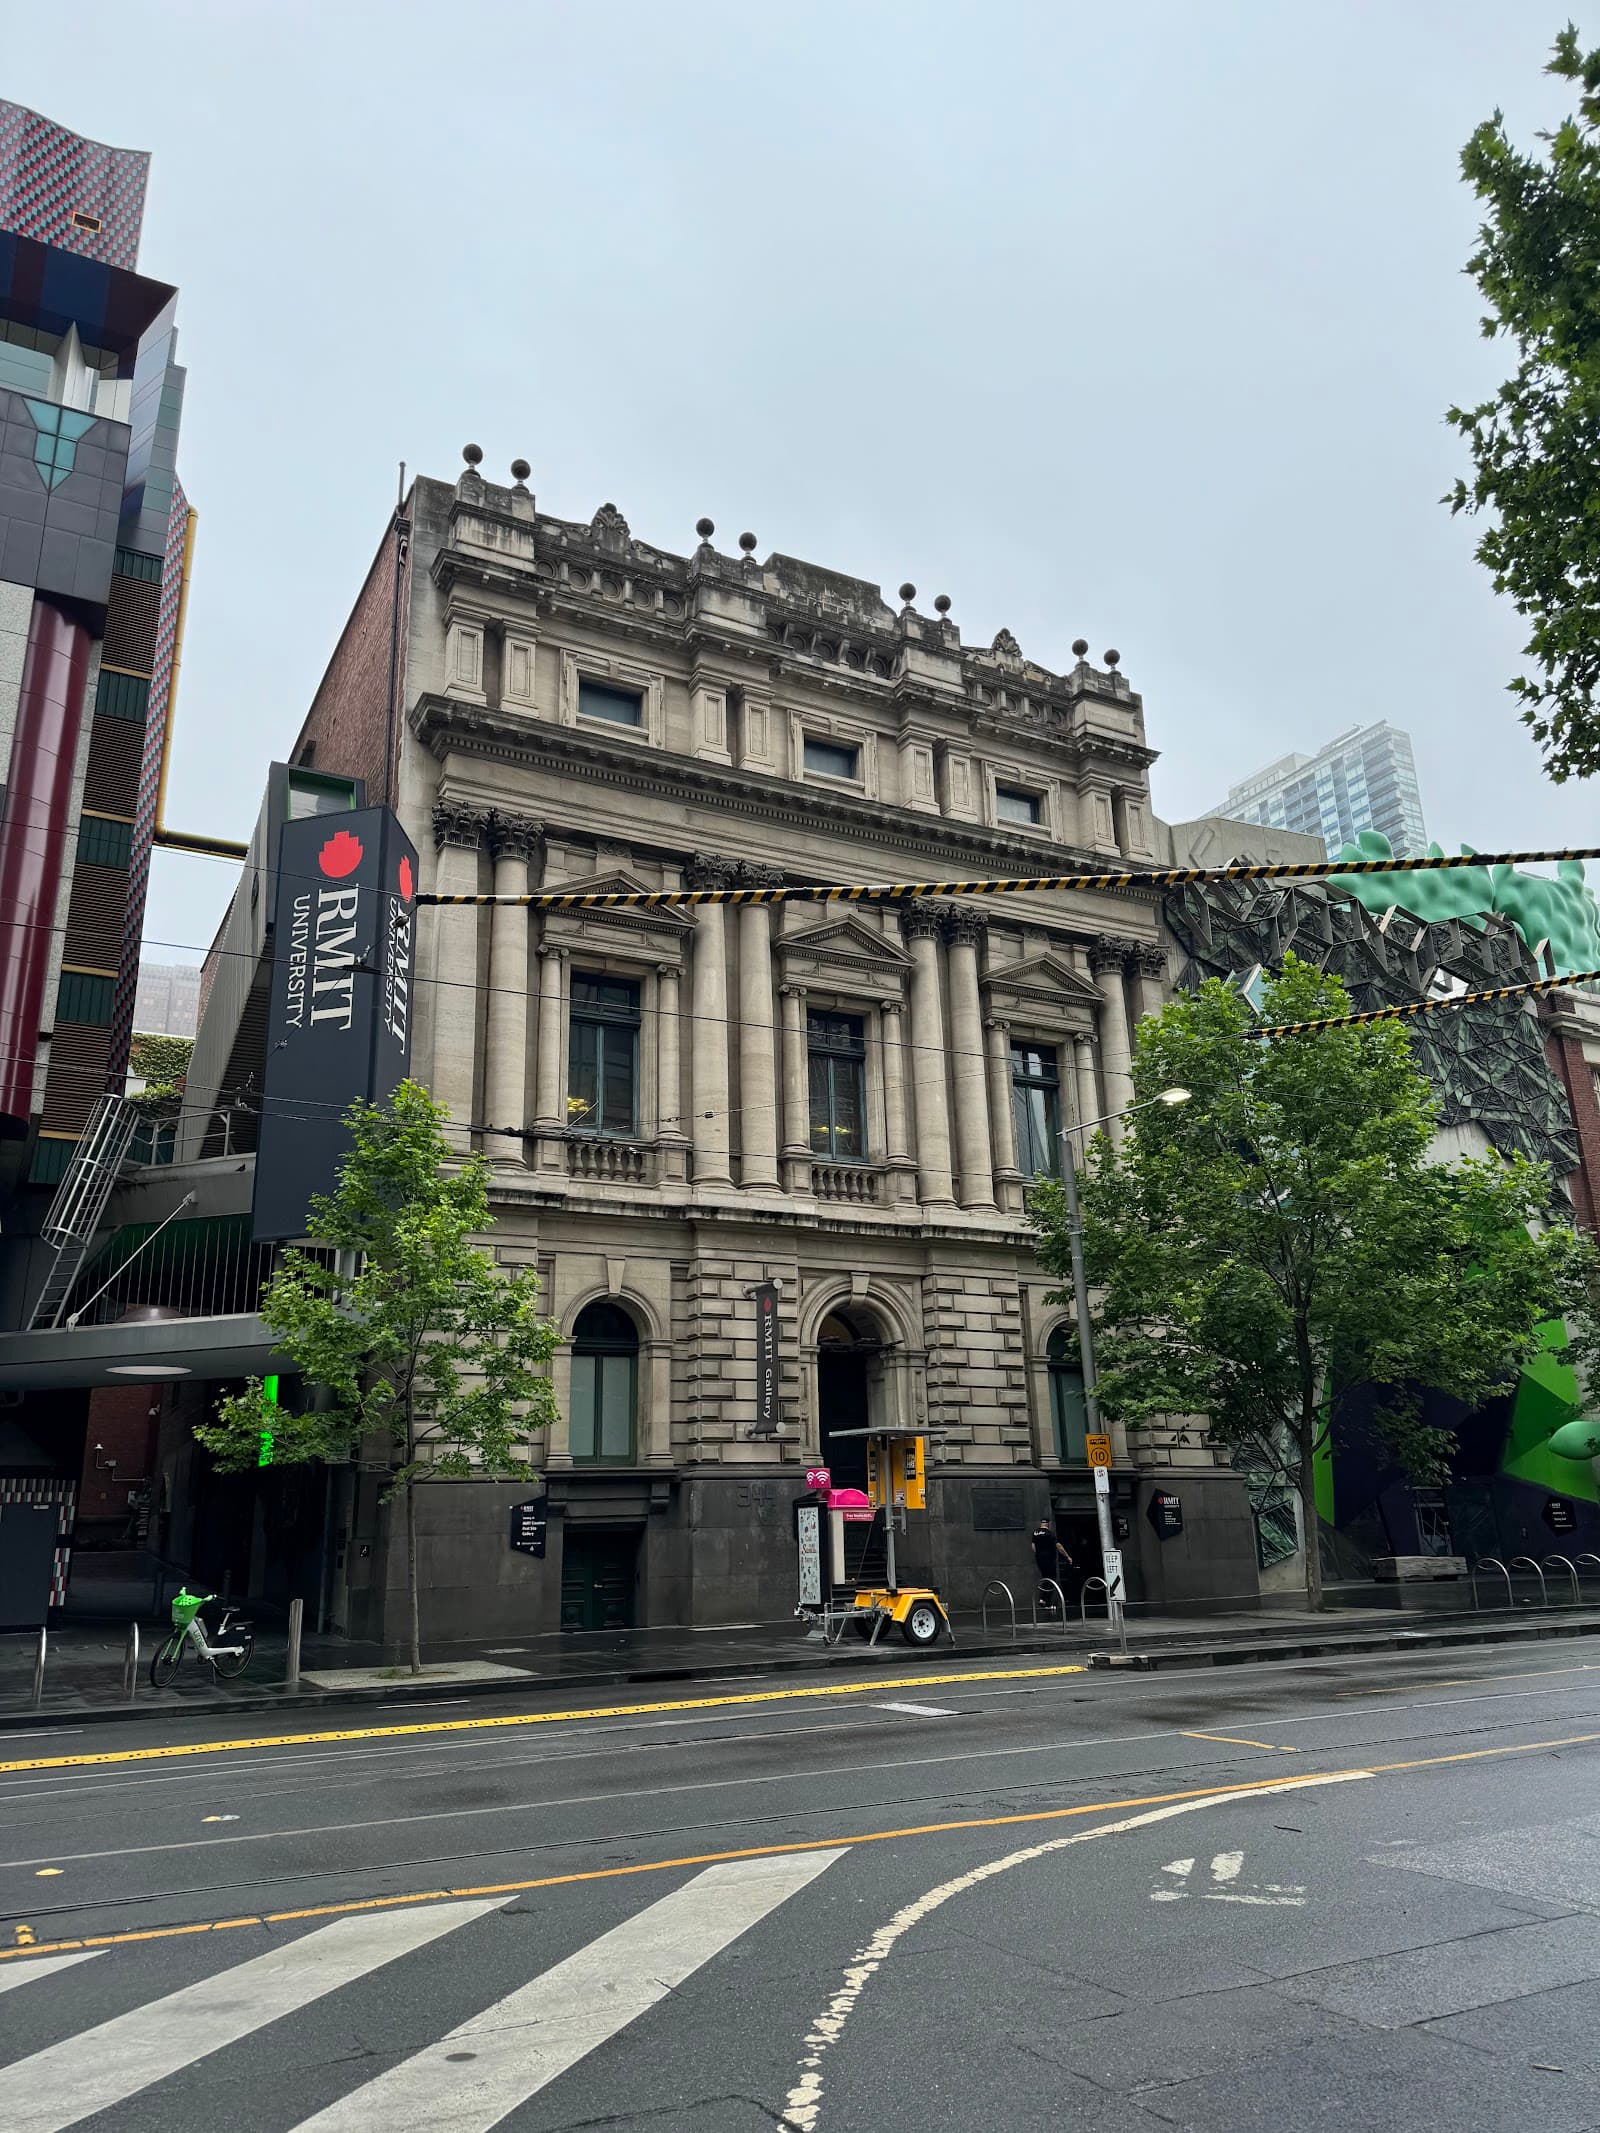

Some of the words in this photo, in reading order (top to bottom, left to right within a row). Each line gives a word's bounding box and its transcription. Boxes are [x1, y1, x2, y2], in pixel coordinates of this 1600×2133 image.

[286, 894, 310, 1028] UNIVERSITY
[310, 883, 359, 1030] RMIT
[392, 902, 411, 1056] RMIT
[764, 1314, 773, 1363] RMIT
[763, 1368, 773, 1419] Gallery
[1094, 1451, 1105, 1462] 10
